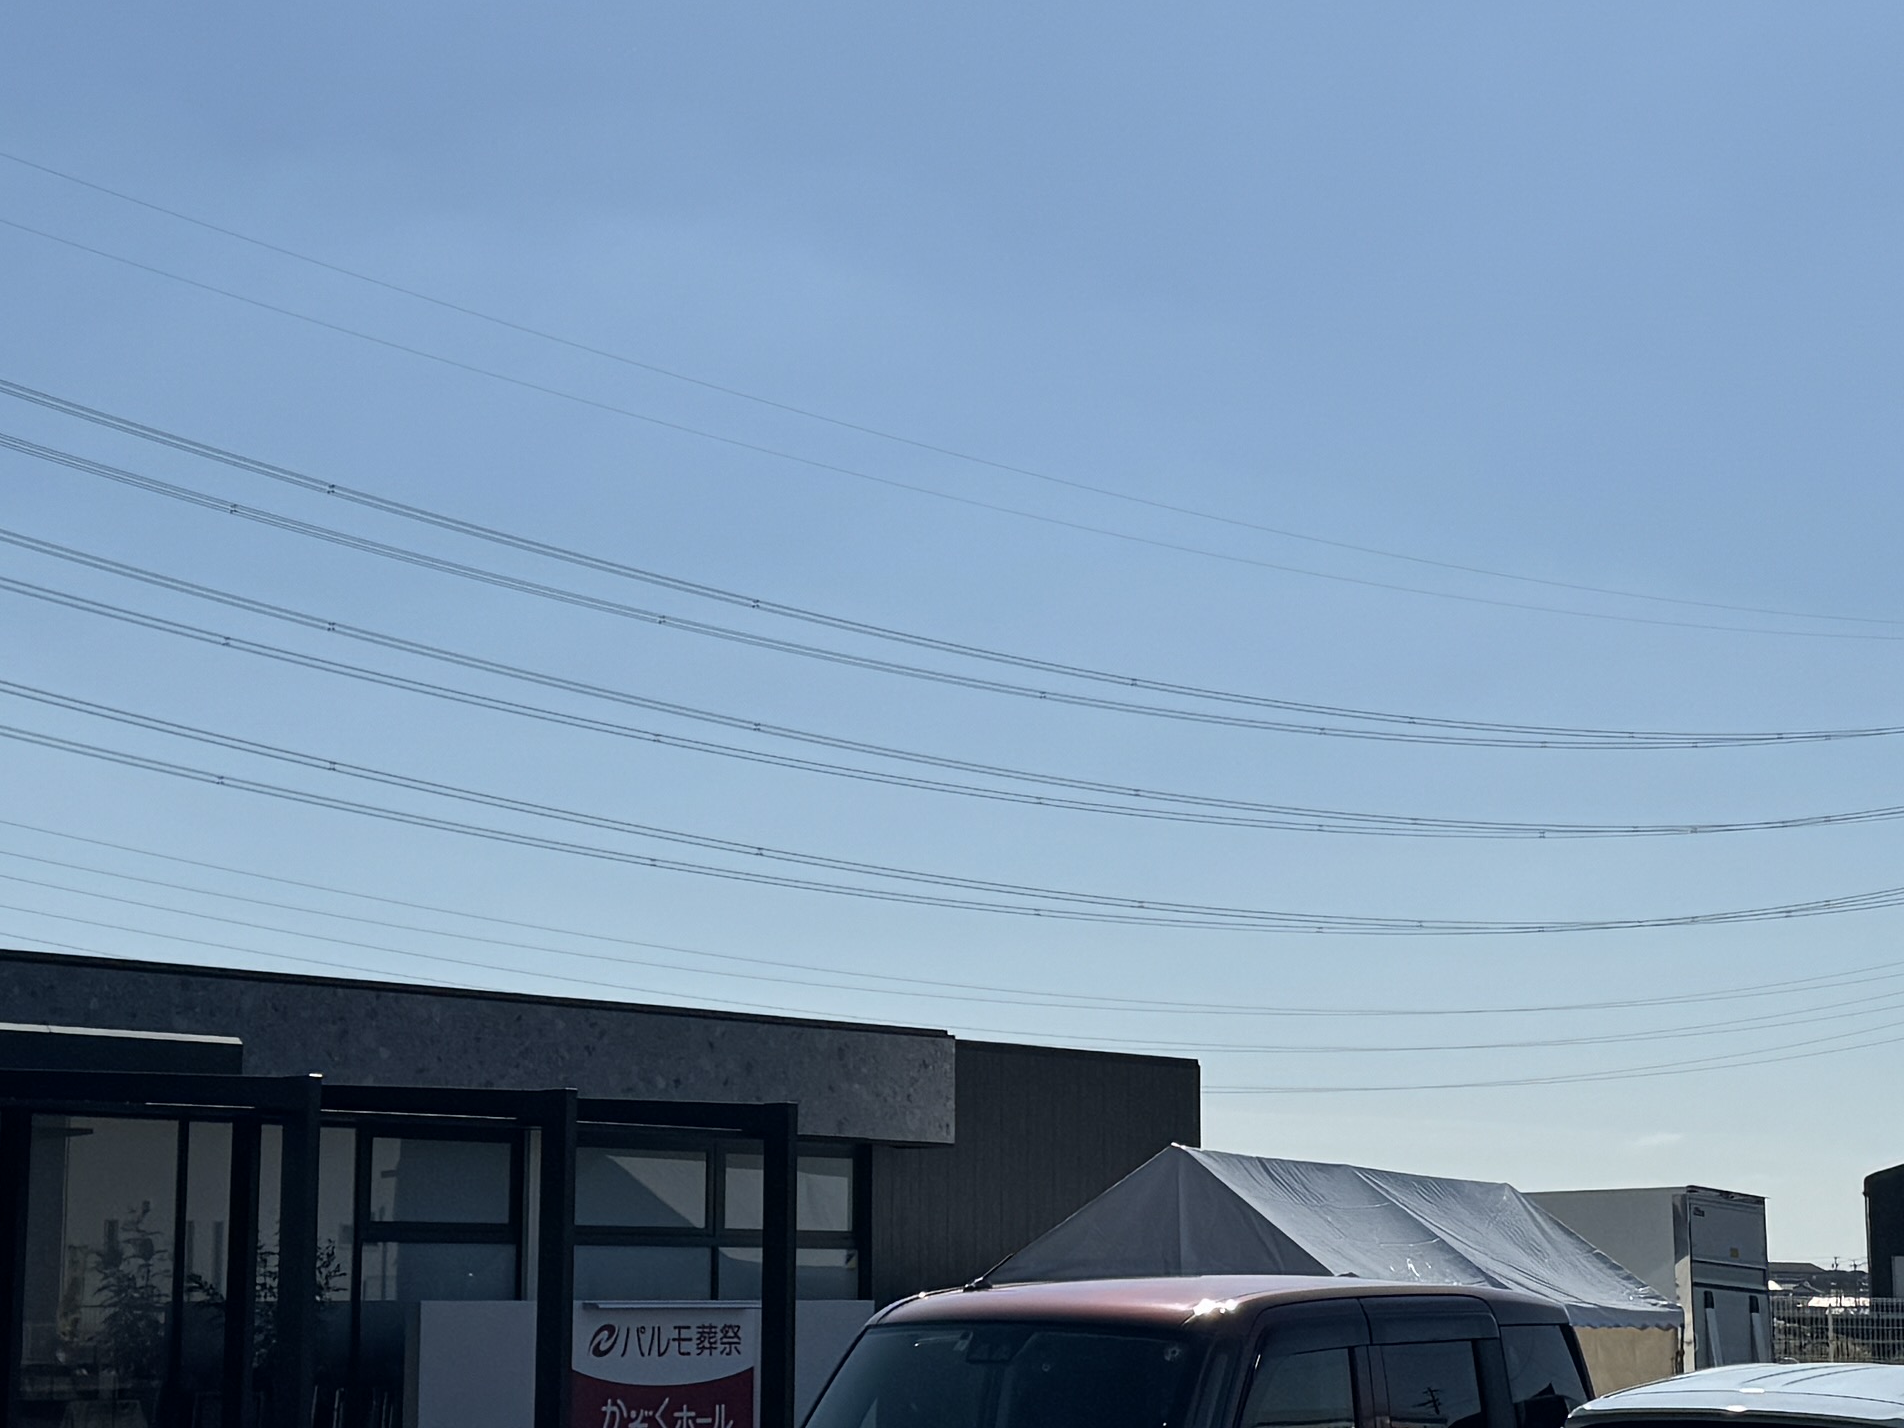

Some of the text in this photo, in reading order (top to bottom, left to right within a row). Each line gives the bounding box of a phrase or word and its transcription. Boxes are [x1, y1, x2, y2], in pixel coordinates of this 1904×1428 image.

[620, 1323, 742, 1358] パルモ葬祭
